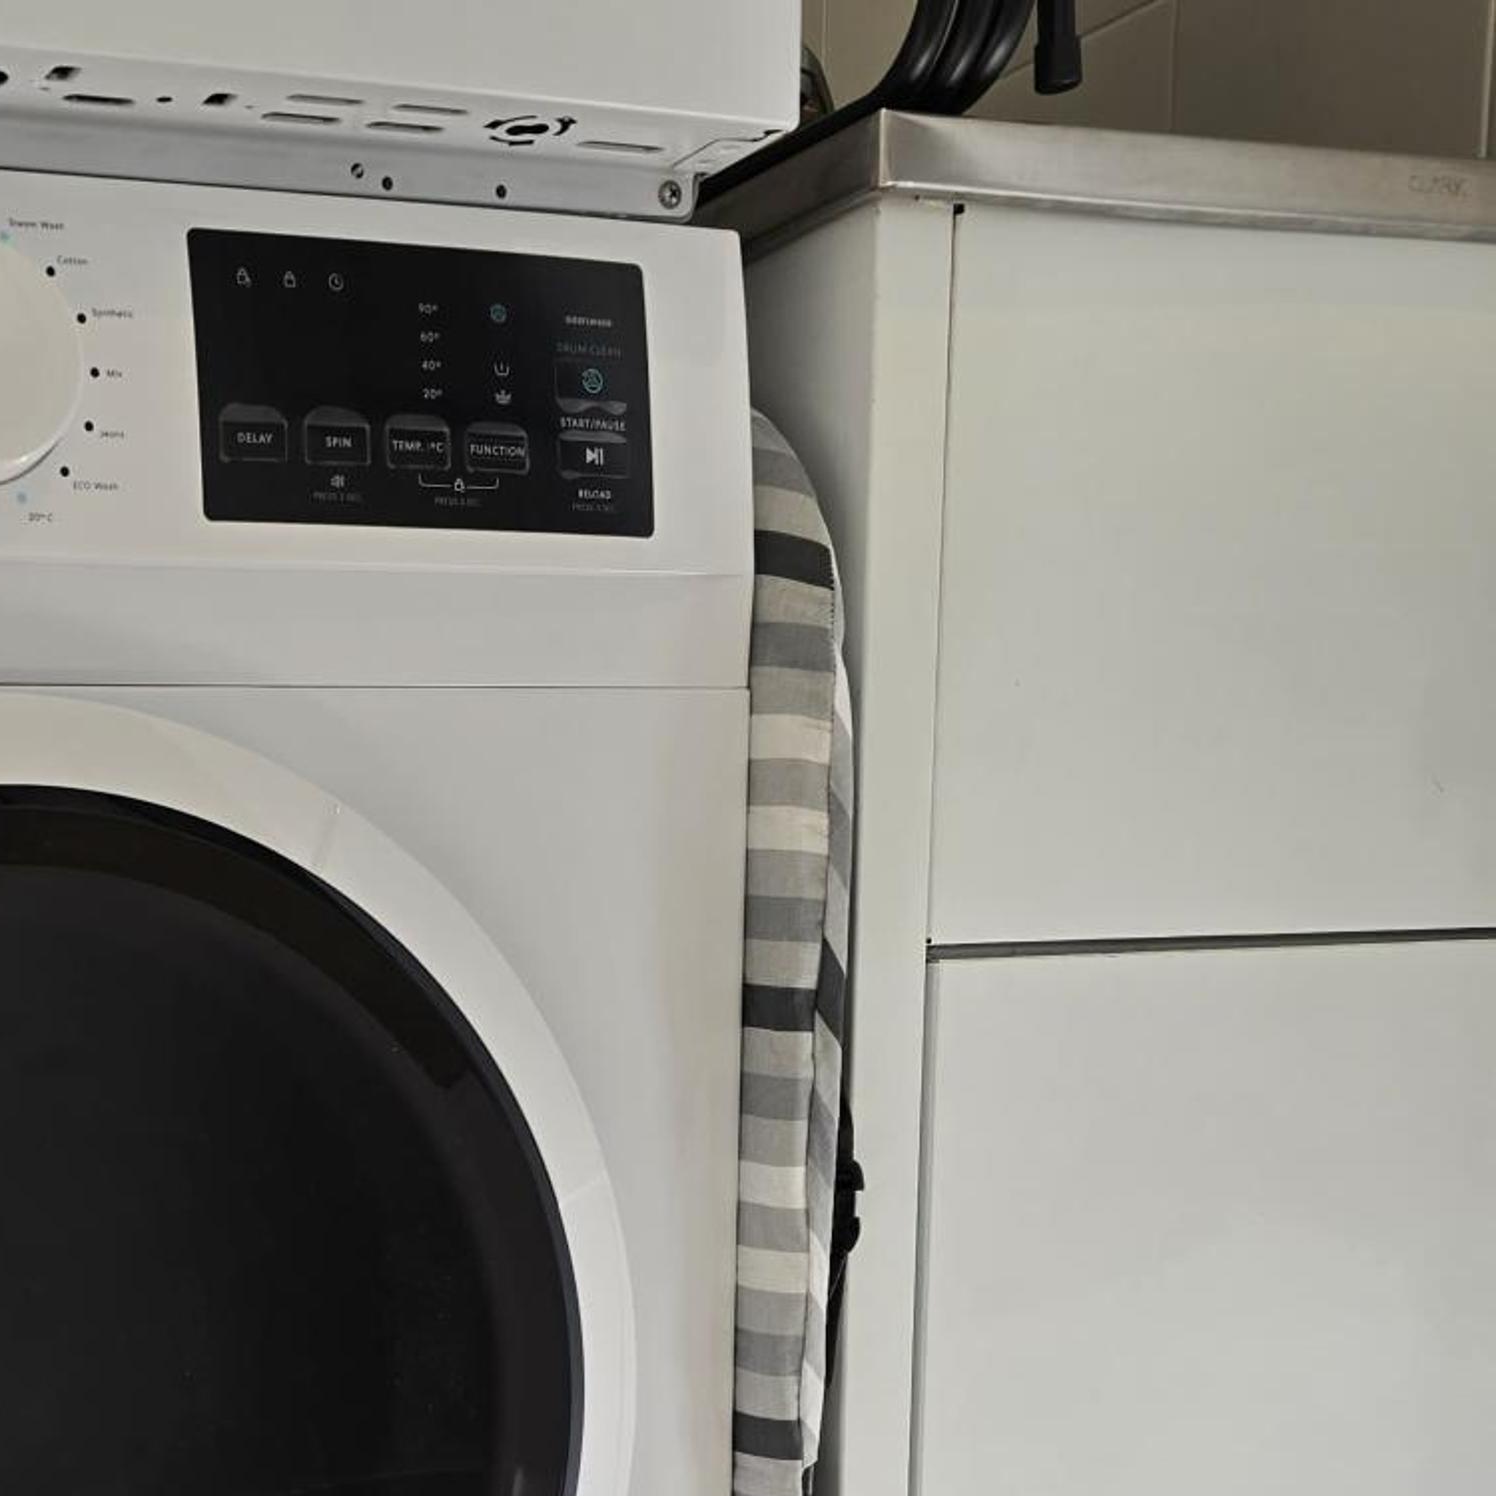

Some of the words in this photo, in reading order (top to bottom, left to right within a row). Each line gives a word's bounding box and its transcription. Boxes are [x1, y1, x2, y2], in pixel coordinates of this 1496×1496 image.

[560, 416, 626, 432] START/PAUSE
[237, 431, 273, 445] DELAY
[325, 436, 353, 449] SPIN
[470, 444, 526, 458] FUNCTION
